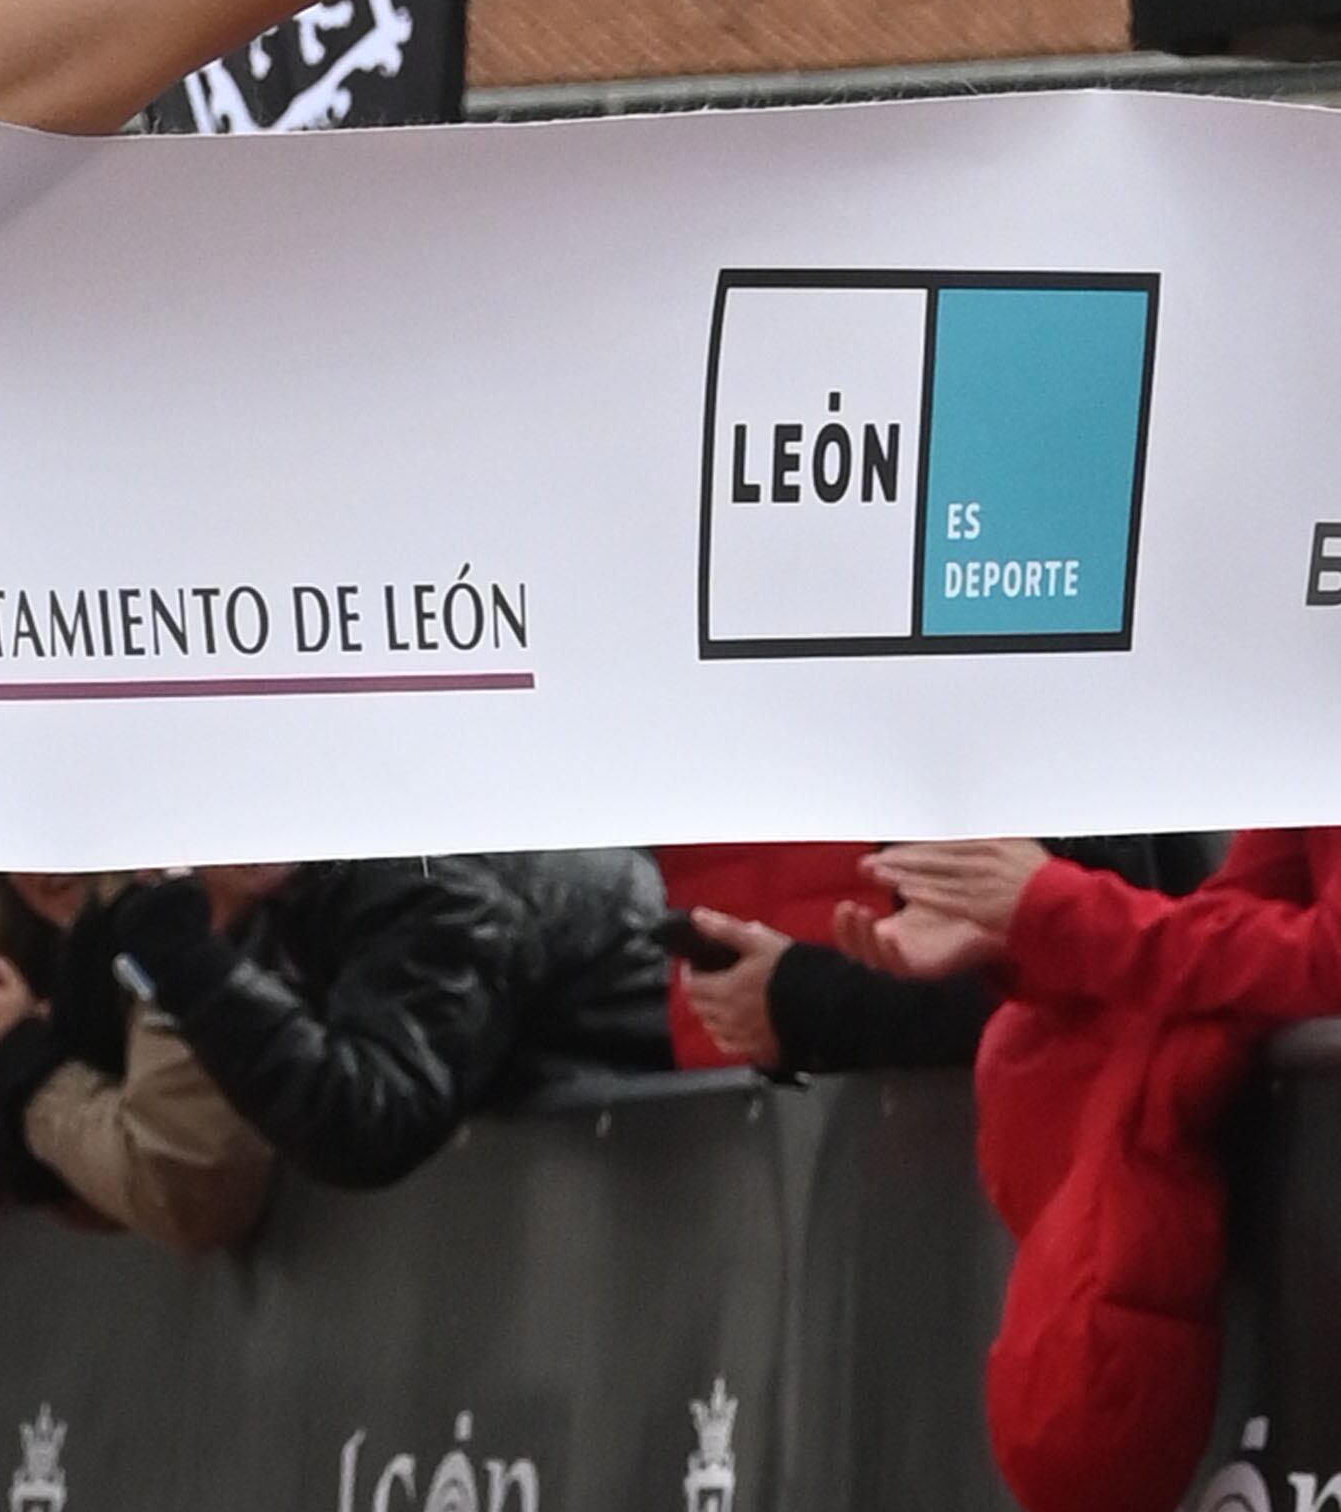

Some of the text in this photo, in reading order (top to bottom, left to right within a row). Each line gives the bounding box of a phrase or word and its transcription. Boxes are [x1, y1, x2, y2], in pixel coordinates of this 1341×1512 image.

[731, 391, 901, 504] LEÓN
[946, 502, 982, 540] ES
[293, 585, 361, 653] DE
[384, 562, 530, 653] LEÓN
[944, 560, 1081, 599] DEPORTE
